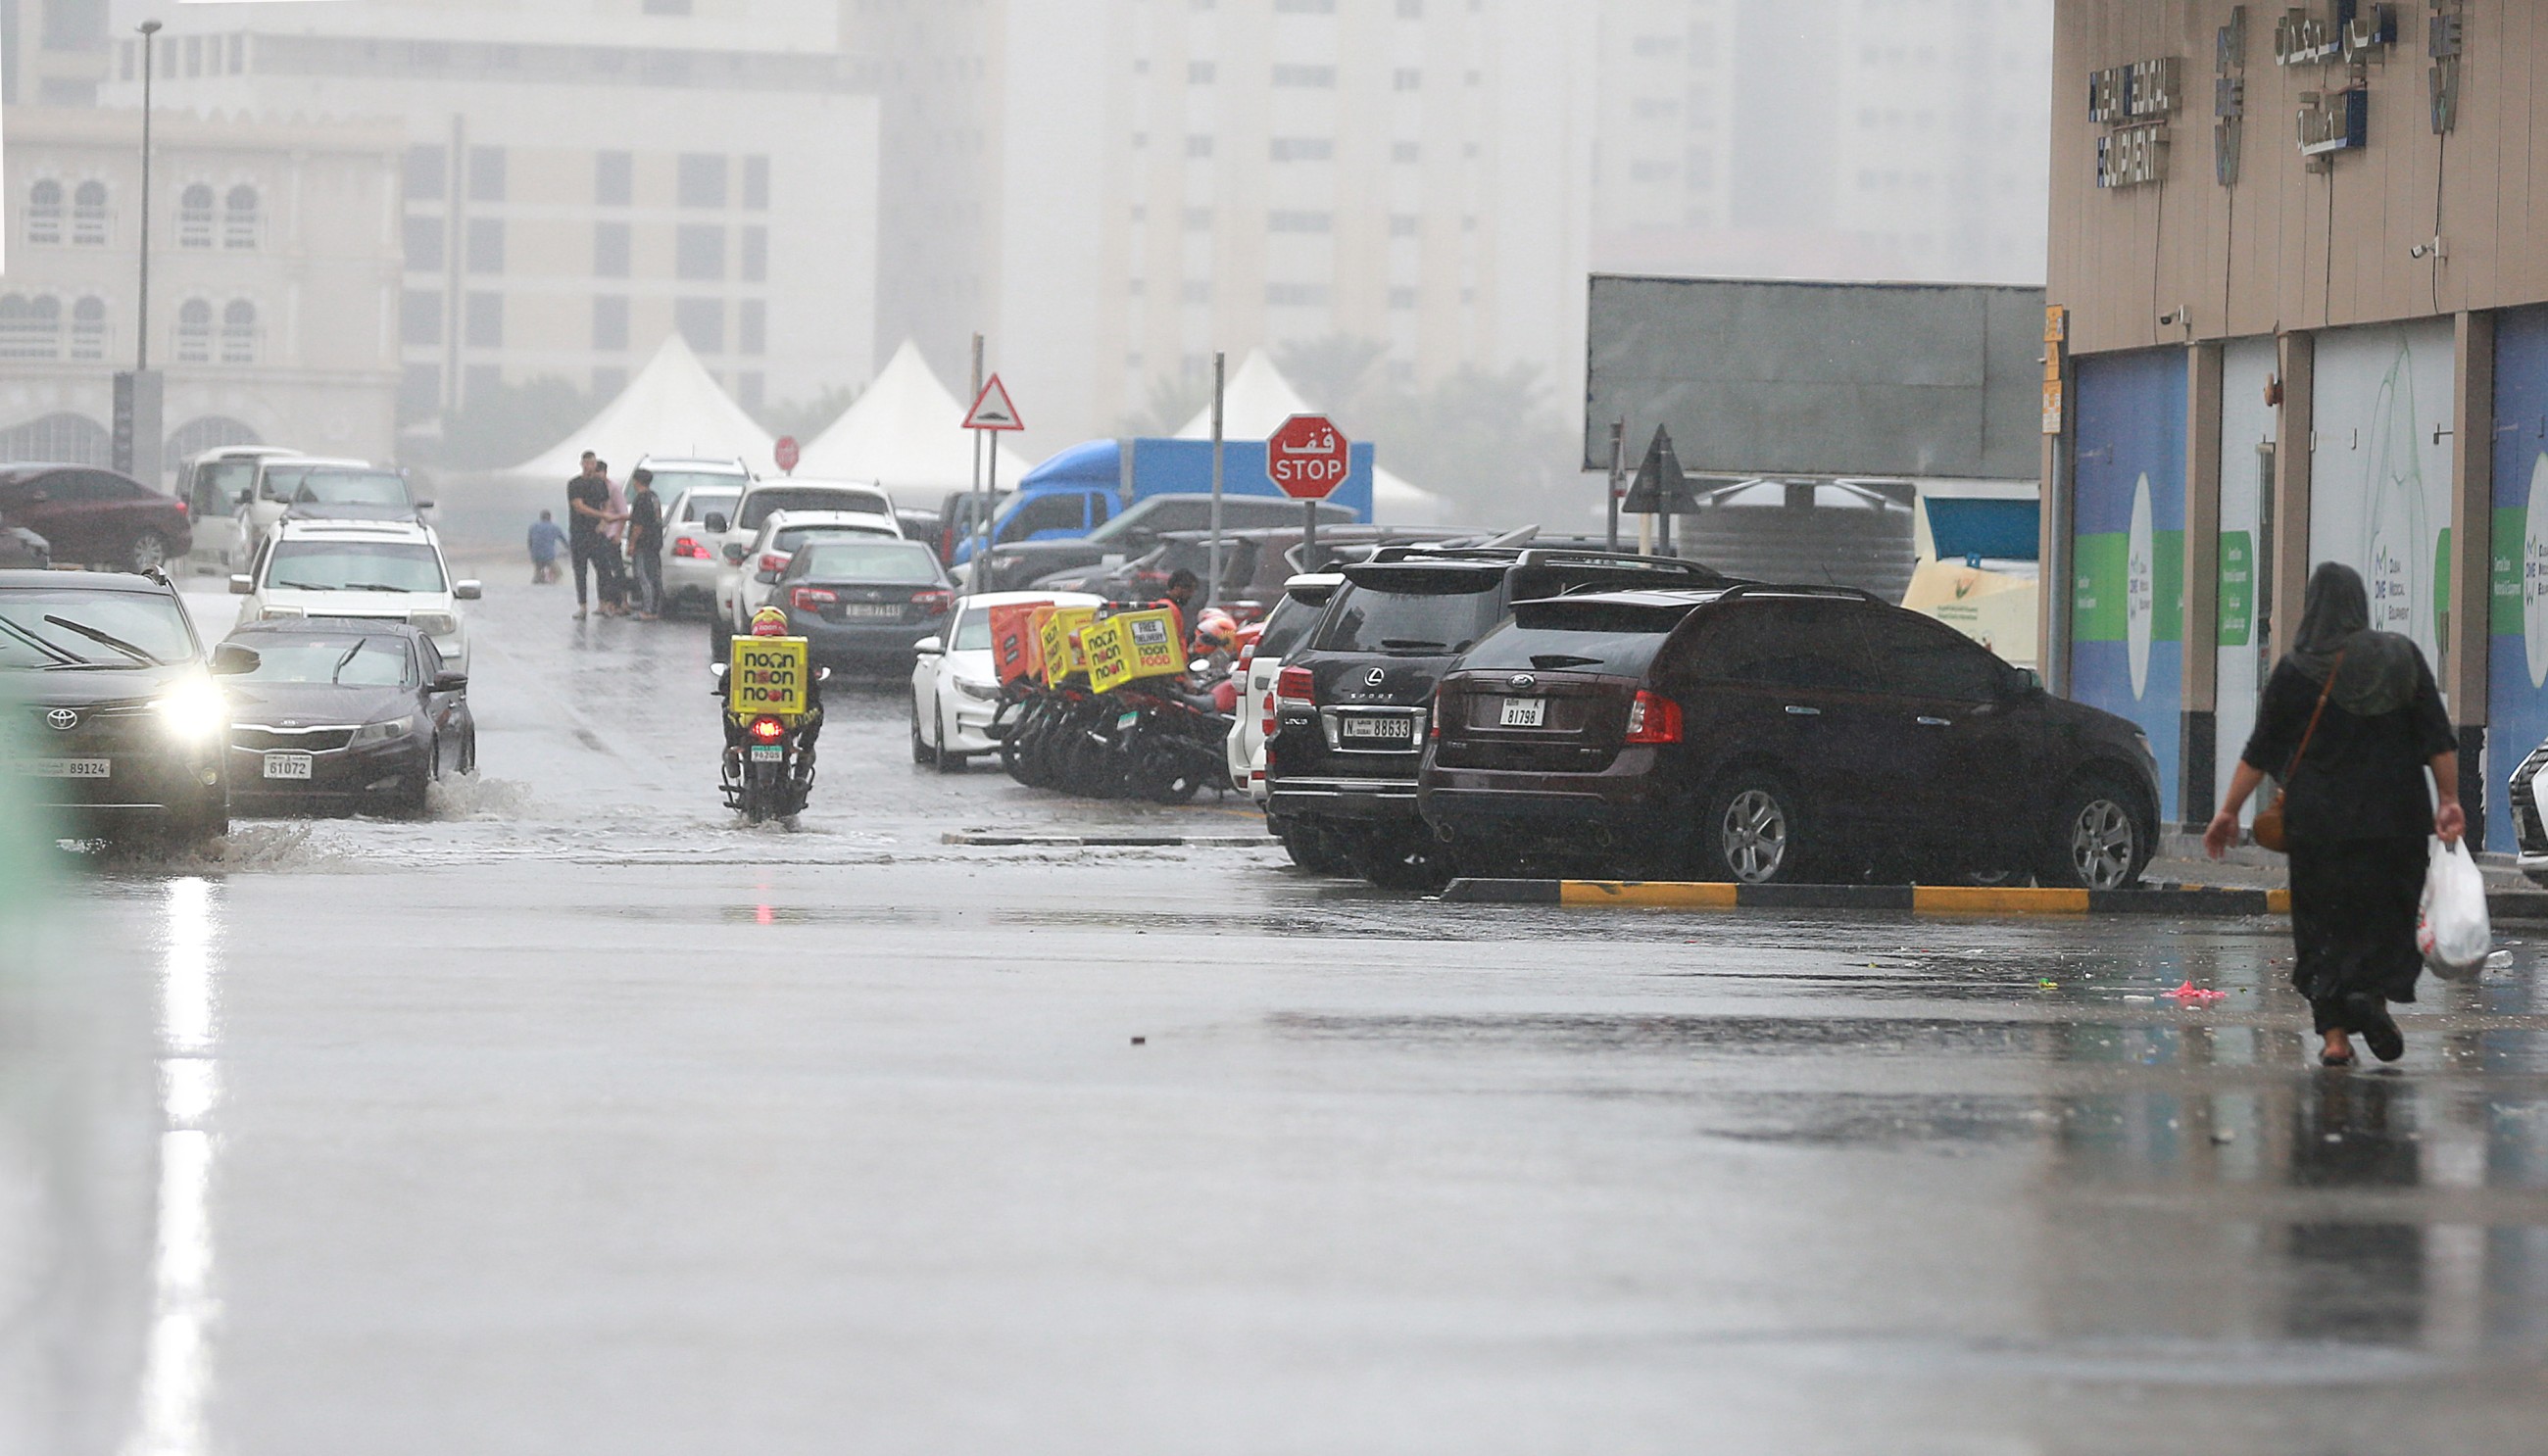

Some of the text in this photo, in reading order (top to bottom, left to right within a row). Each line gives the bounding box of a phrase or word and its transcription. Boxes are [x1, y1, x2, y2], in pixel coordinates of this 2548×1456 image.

[1282, 427, 1335, 454] قف
[1276, 460, 1342, 479] STOP
[1138, 621, 1156, 633] FREE
[1135, 633, 1163, 643] DELIVERY
[1139, 645, 1168, 655] noon
[745, 652, 795, 668] noon
[1141, 655, 1170, 666] FOOD
[744, 669, 794, 685] noon
[743, 687, 793, 703] noon
[1507, 709, 1537, 724] 81798
[1347, 720, 1407, 737] N 88633
[70, 763, 105, 774] 89124
[270, 762, 306, 774] 61072
